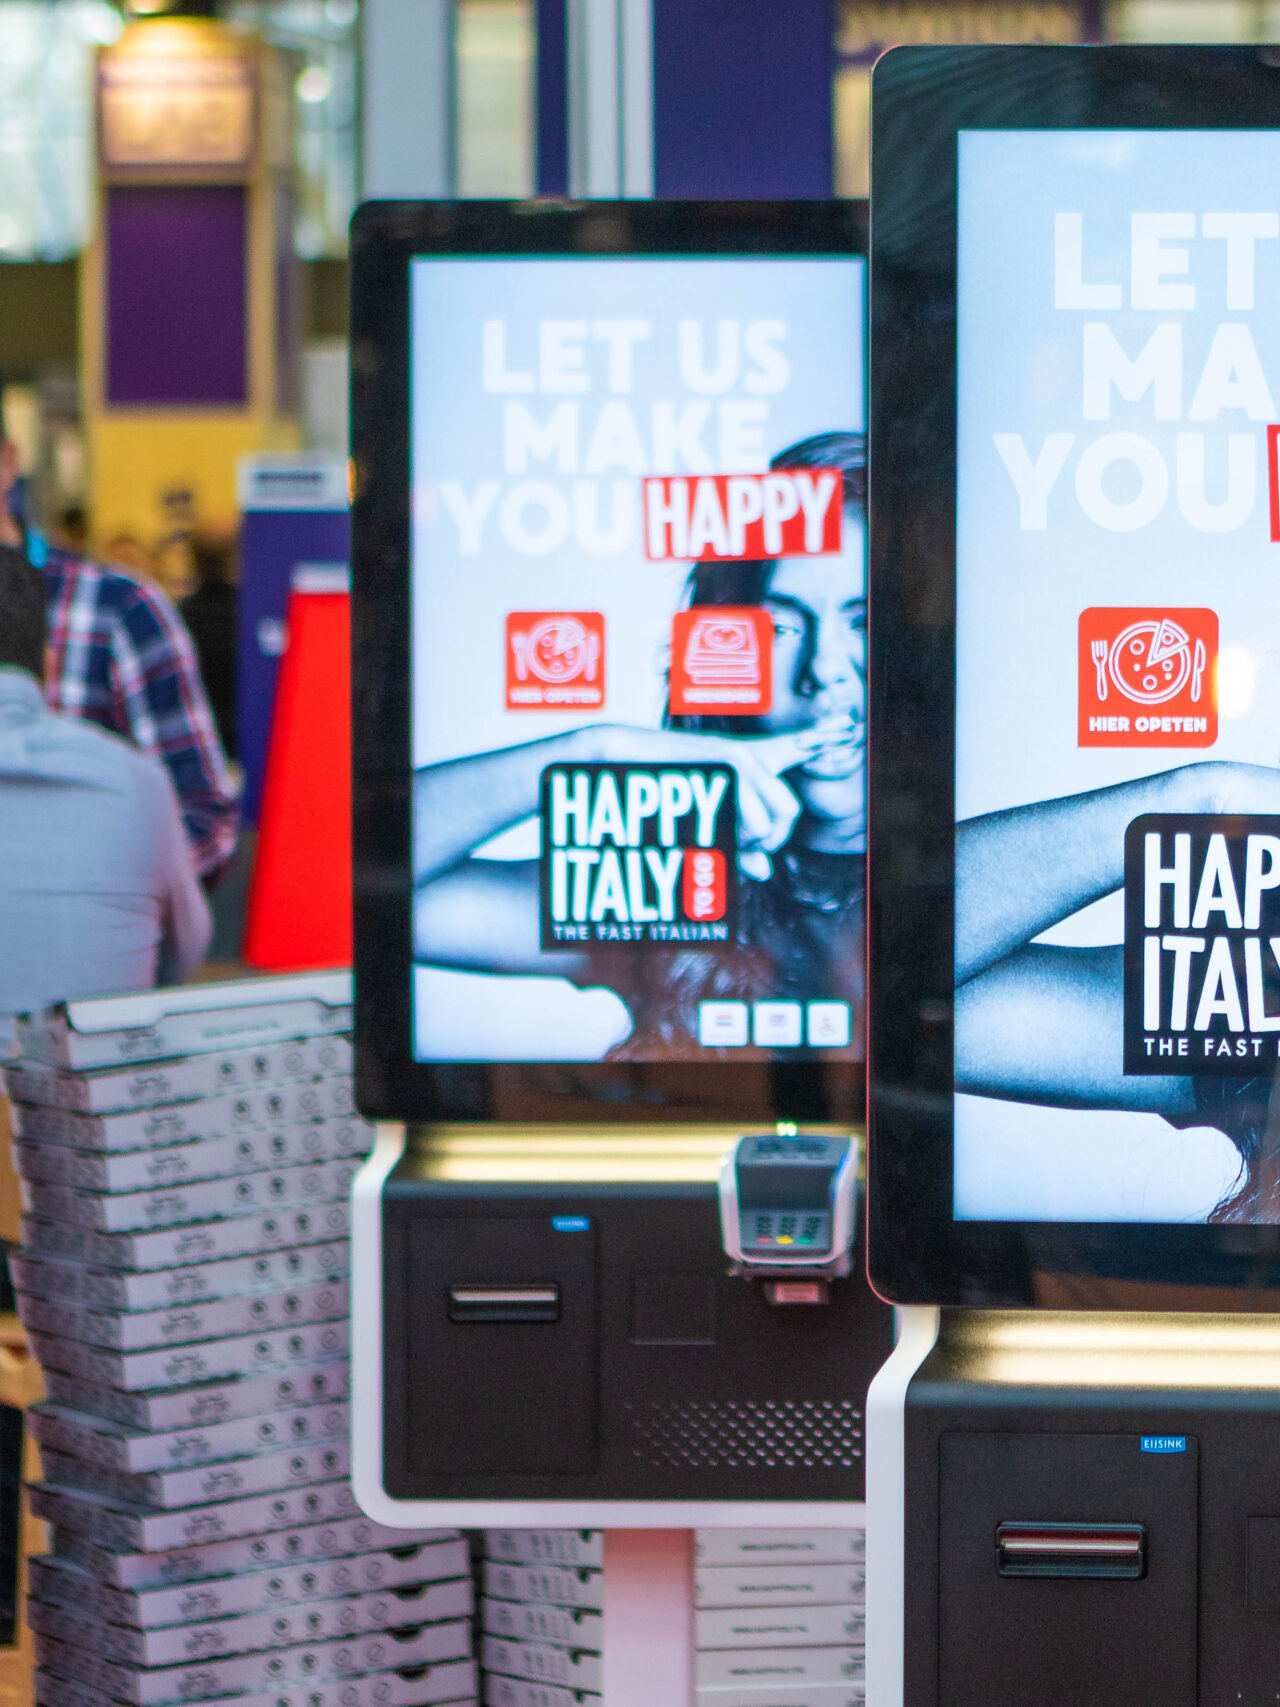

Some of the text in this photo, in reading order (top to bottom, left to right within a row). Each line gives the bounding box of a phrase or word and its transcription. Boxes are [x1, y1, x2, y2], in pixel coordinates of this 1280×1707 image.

[1054, 212, 1279, 310] LET
[482, 318, 791, 394] LET US
[505, 400, 769, 475] MAKE
[440, 474, 837, 559] YOU HAPPY
[992, 432, 1257, 533] YOU
[1089, 716, 1207, 733] HIER OPETEN
[552, 771, 730, 848] HAPPY
[552, 847, 684, 923] ITALY
[554, 923, 729, 940] THE FAST ITALIAN
[1144, 1038, 1189, 1056] THE
[1204, 1038, 1263, 1057] FAST
